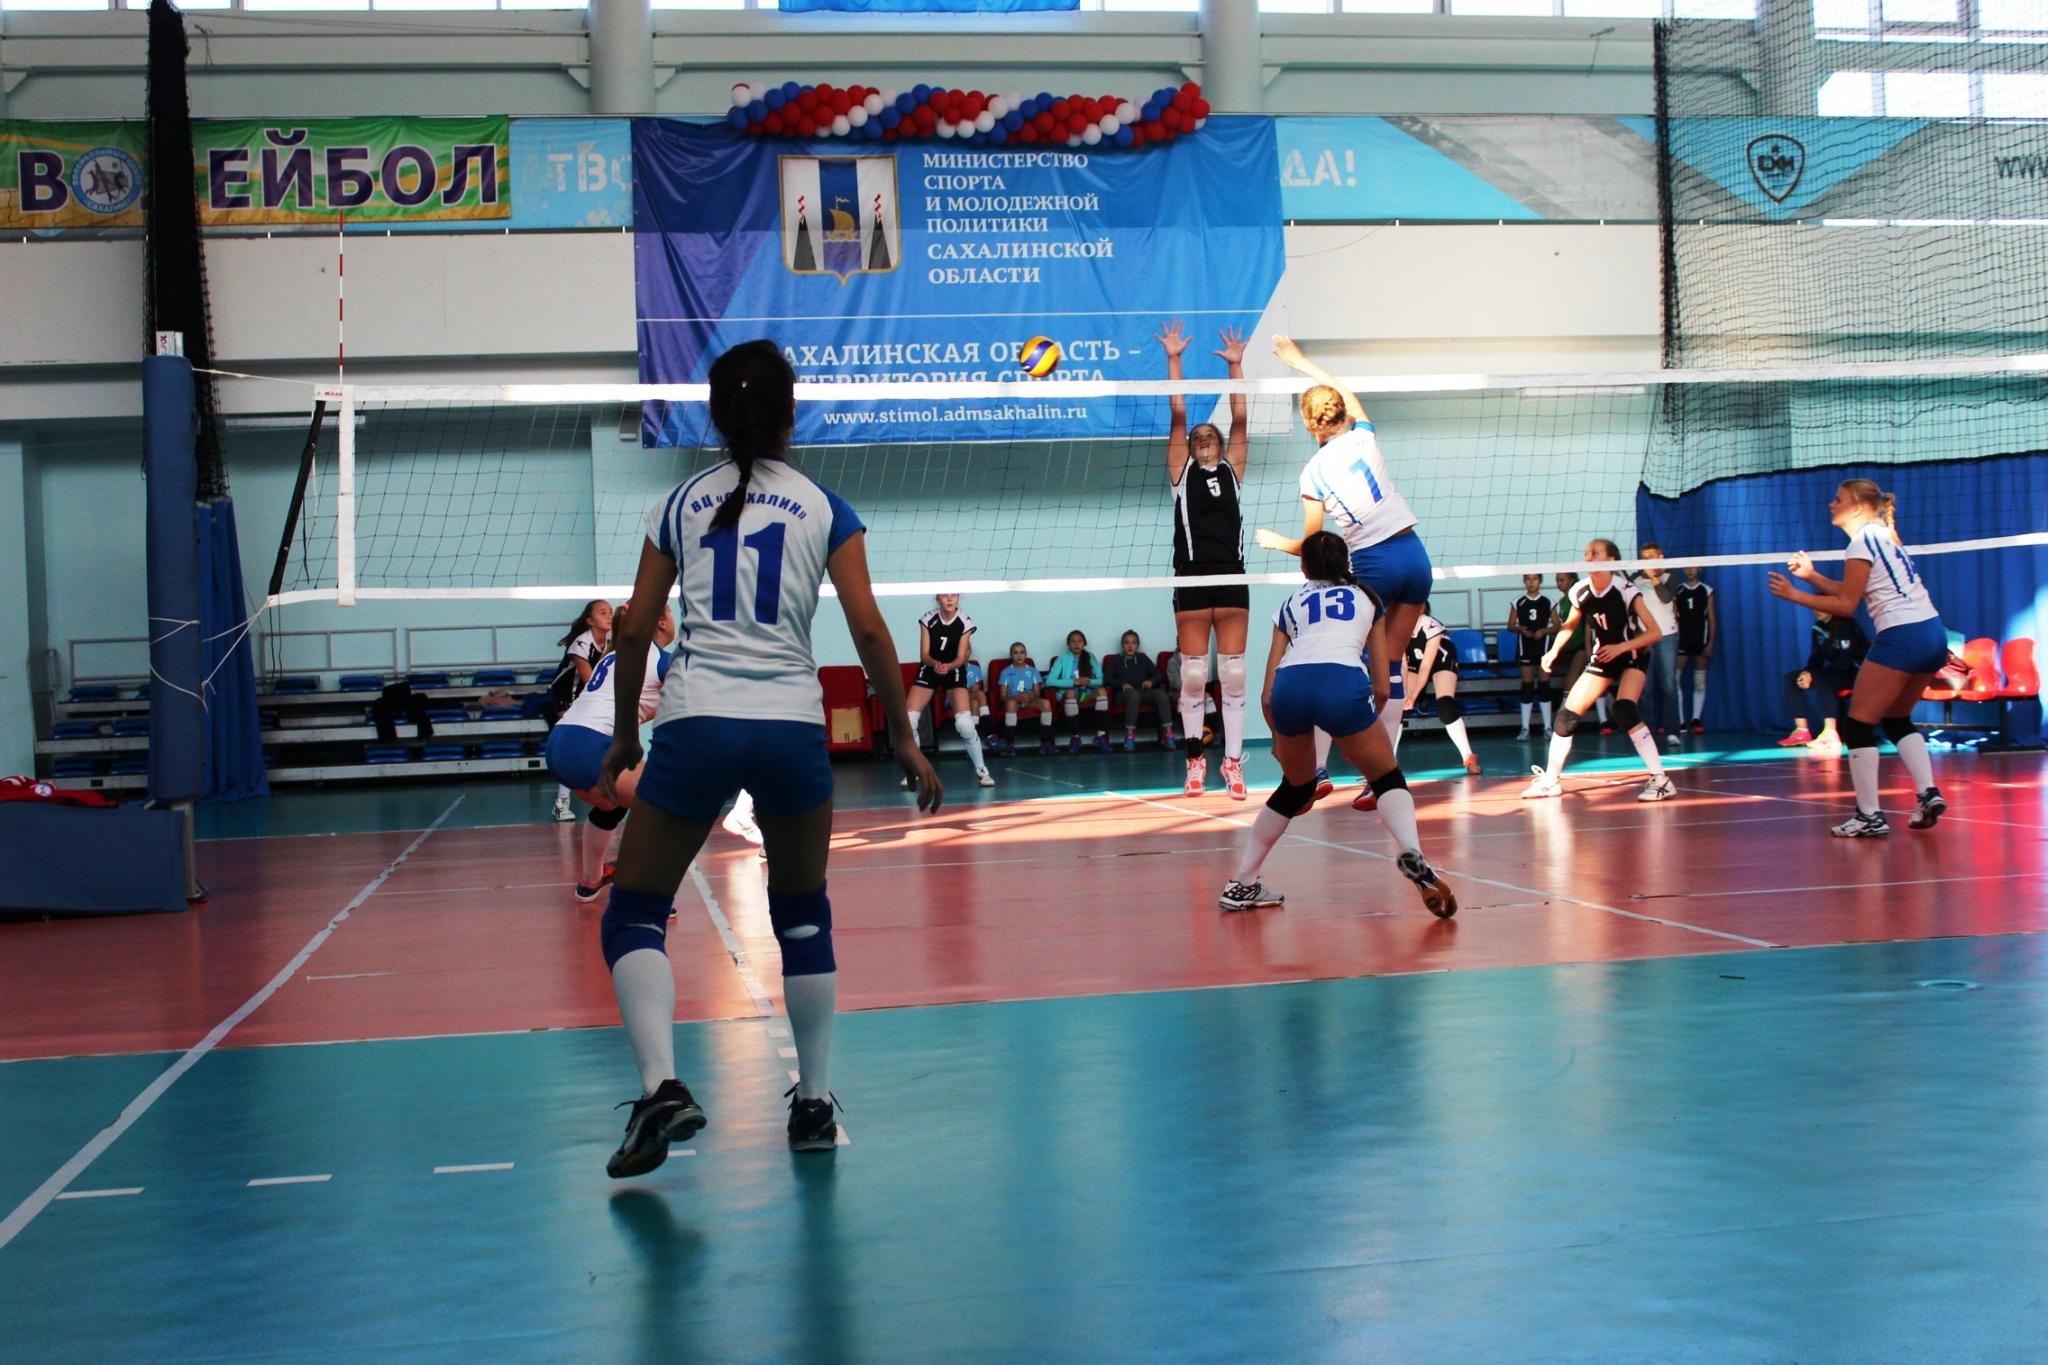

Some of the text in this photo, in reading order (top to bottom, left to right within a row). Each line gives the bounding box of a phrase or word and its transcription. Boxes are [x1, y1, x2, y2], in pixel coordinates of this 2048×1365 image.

[923, 153, 1088, 169] МИНИСТЕРСТВО
[924, 175, 1005, 190] СПОРТА
[926, 193, 1100, 213] И МОЛОДЕЖНОЙ
[927, 217, 1049, 233] ПОЛИТИКИ
[927, 237, 1114, 259] САХАЛИНСКОЙ
[928, 267, 1041, 284] ОБЛАСТИ
[783, 342, 980, 367] АХАЛИНСКАЯ
[823, 403, 1088, 425] www.stimol.admsakhalin.ru
[1205, 476, 1222, 497] 5
[691, 495, 714, 514] ВЦ
[700, 519, 786, 625] 11
[1300, 588, 1356, 625] 13
[1687, 598, 1694, 609] 1
[1529, 608, 1537, 620] 3
[1593, 612, 1608, 631] 11
[940, 636, 948, 650] 7
